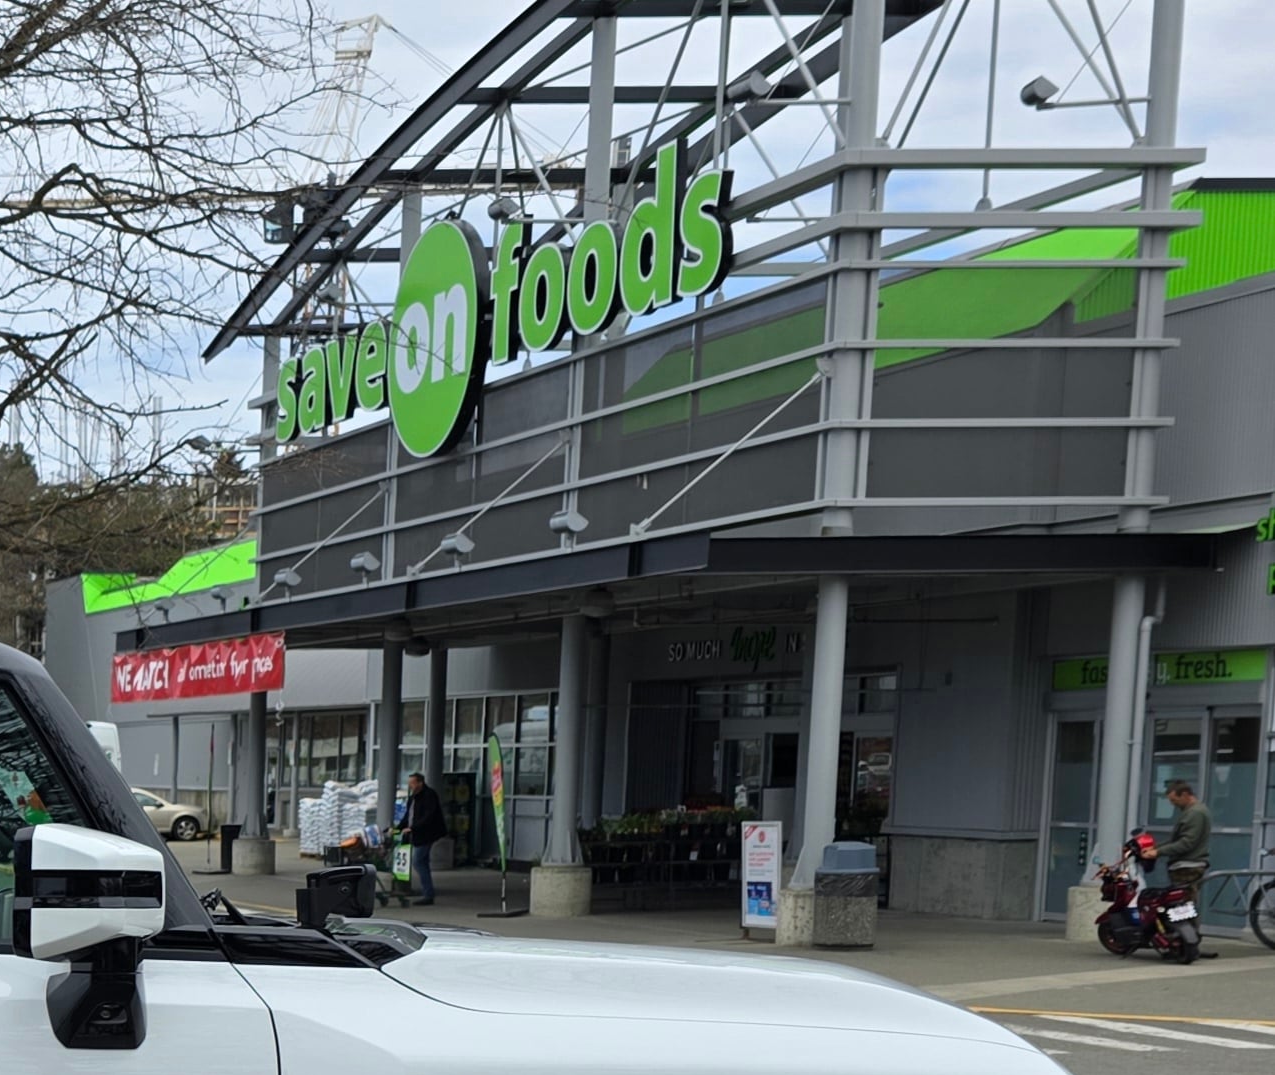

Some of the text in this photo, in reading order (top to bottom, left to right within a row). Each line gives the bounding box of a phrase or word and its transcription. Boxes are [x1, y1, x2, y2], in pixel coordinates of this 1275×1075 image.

[275, 138, 725, 445] save on foods
[668, 642, 684, 662] SO
[686, 639, 721, 660] MUCH
[1175, 652, 1233, 681] fresh.
